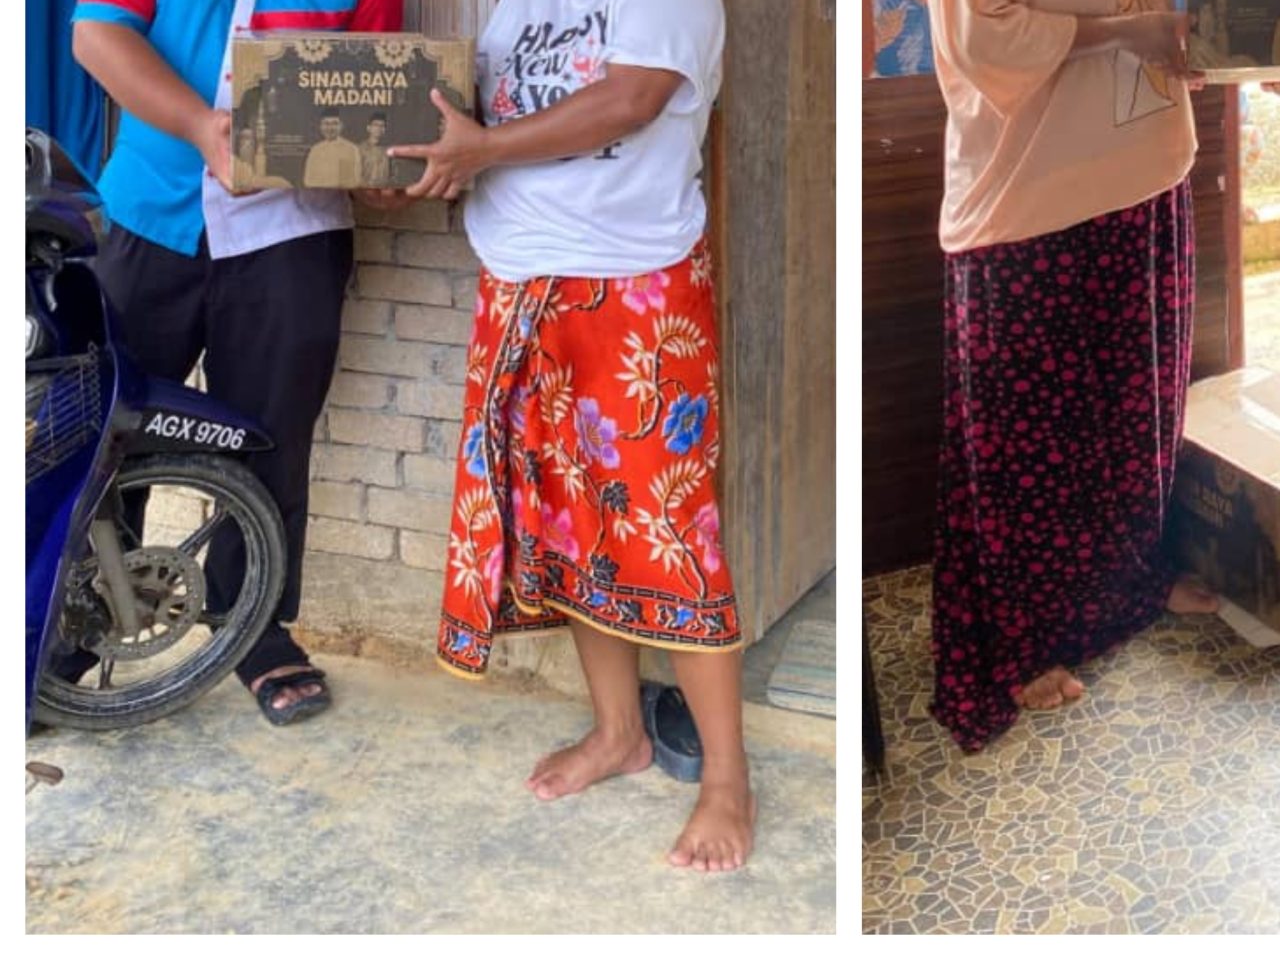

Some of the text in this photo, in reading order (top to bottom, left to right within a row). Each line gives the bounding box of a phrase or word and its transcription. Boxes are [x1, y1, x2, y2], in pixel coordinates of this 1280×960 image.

[298, 70, 408, 89] SINAR RAYA
[313, 89, 393, 106] MADANI
[144, 411, 246, 450] AGX 9706
